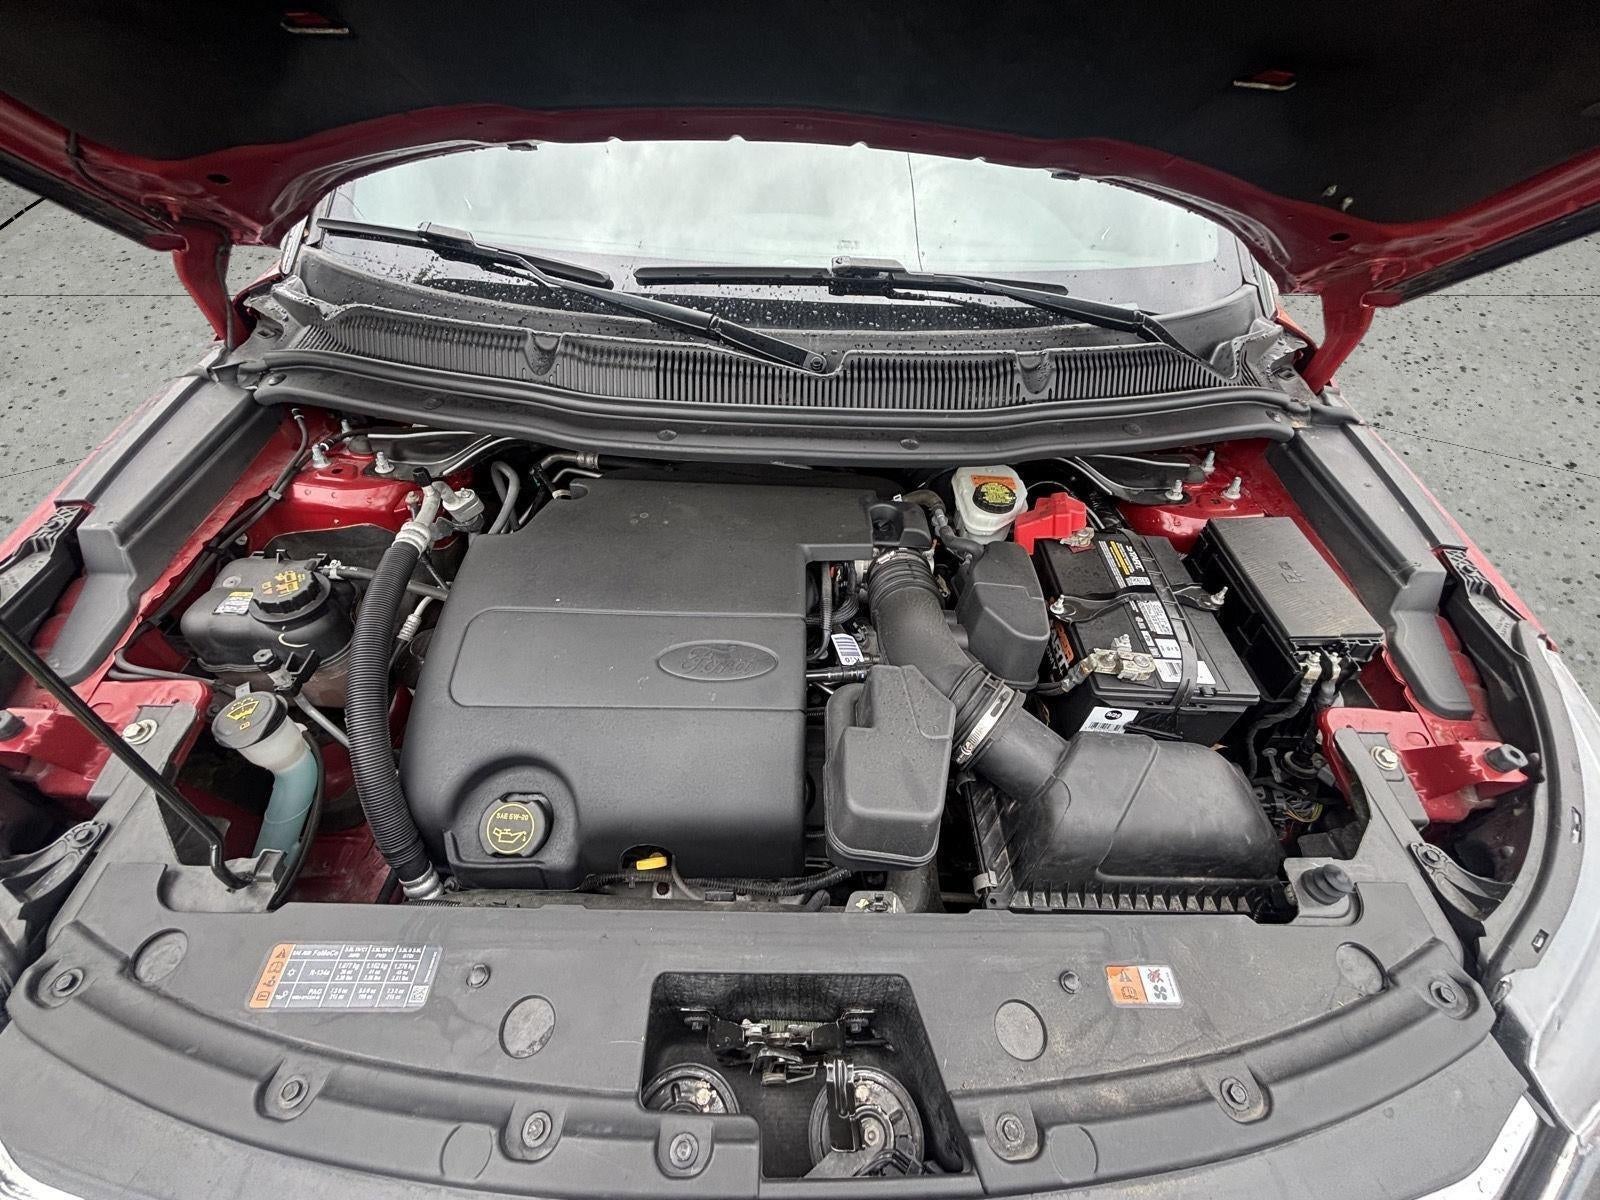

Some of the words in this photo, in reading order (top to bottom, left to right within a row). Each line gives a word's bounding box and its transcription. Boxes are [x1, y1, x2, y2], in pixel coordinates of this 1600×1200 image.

[496, 812, 508, 820] SAE
[509, 813, 529, 821] 5W-20
[312, 949, 339, 957] FoMoCo
